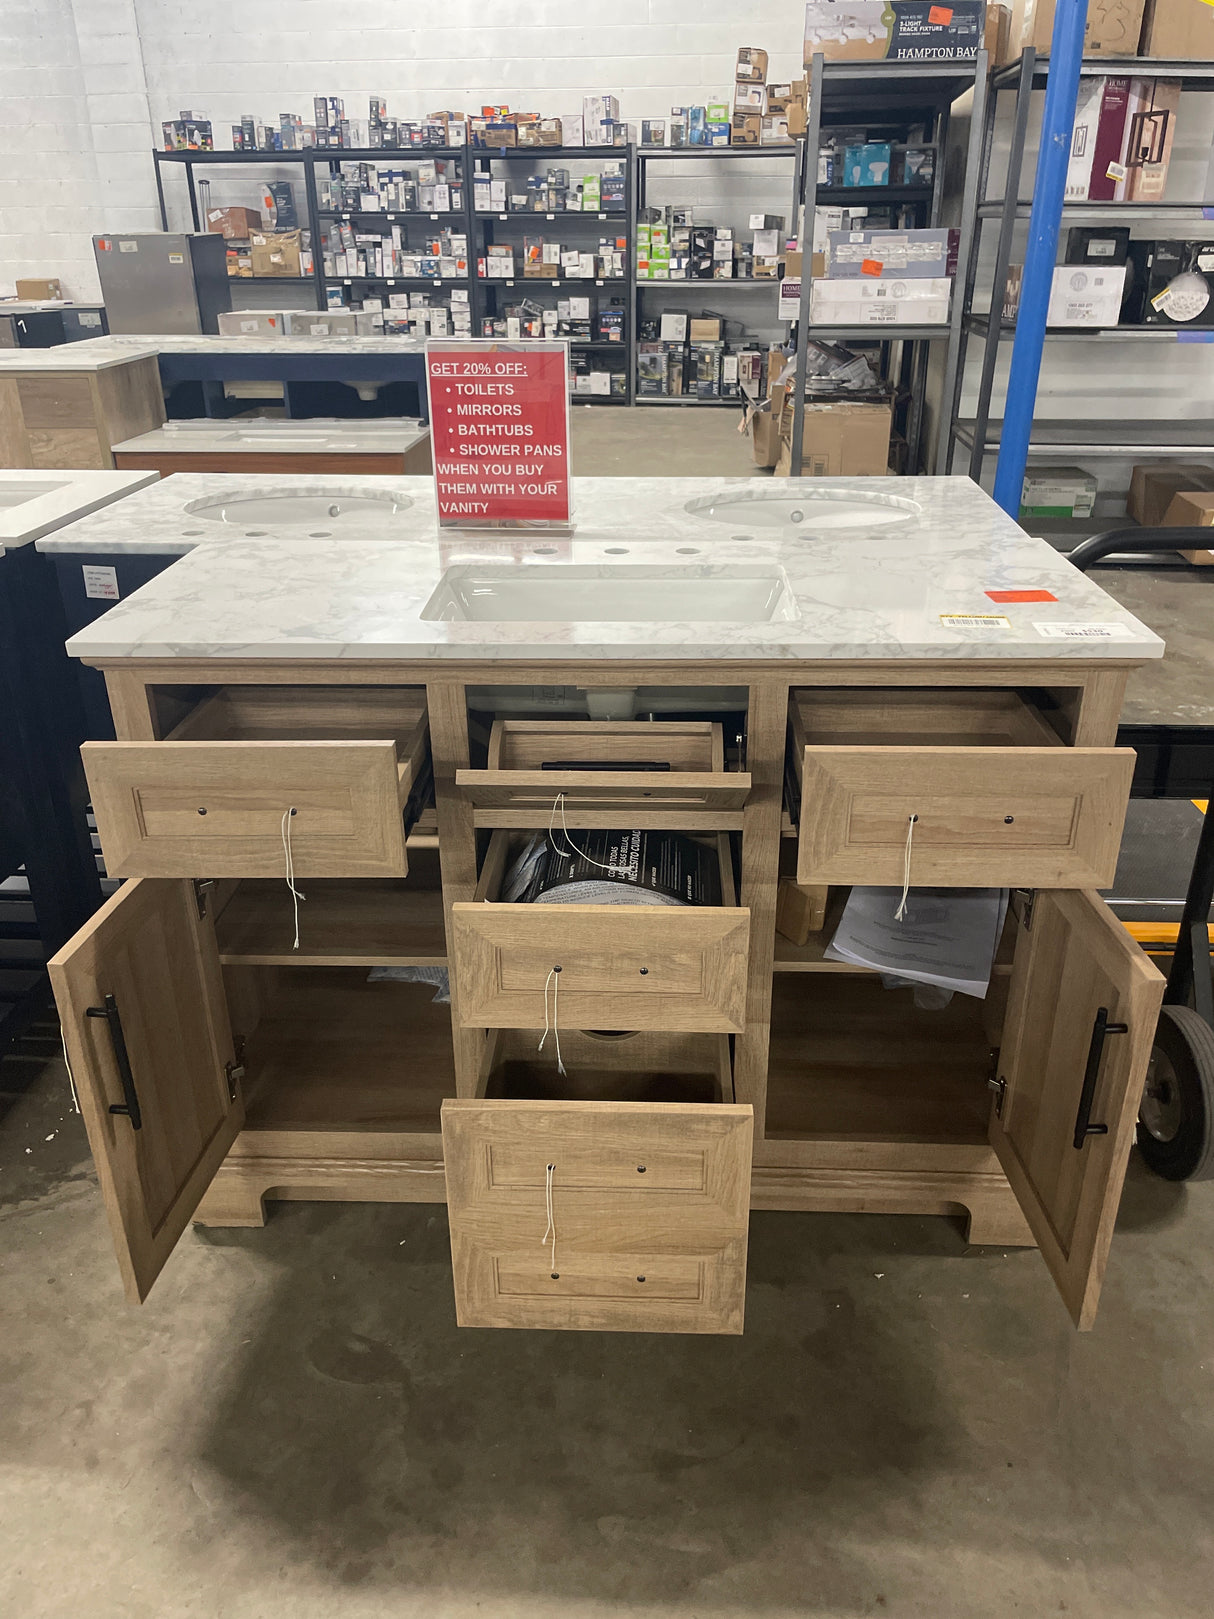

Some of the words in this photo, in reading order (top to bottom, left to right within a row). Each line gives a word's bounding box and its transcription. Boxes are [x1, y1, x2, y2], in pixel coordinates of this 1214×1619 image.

[898, 48, 954, 59] HAMPTON
[957, 47, 977, 57] BAY
[431, 363, 460, 375] GET
[463, 363, 491, 375] 20%
[494, 363, 528, 375] OFF:
[456, 384, 514, 395] TOILETS
[457, 404, 522, 416] MIRRORS
[458, 424, 534, 436] BATHTUBS
[459, 444, 521, 456] SHOWER
[524, 445, 562, 457] PANS
[438, 464, 478, 475] WHEN
[482, 464, 512, 476] YOU
[515, 464, 544, 476] BUY
[439, 483, 477, 494] THEM
[480, 483, 515, 494] WITH
[518, 483, 557, 495] YOUR
[440, 502, 489, 513] VANITY
[610, 846, 618, 862] TODAS
[620, 853, 628, 869] OSAS
[628, 851, 639, 882] NECESITO
[608, 862, 617, 878] COO
